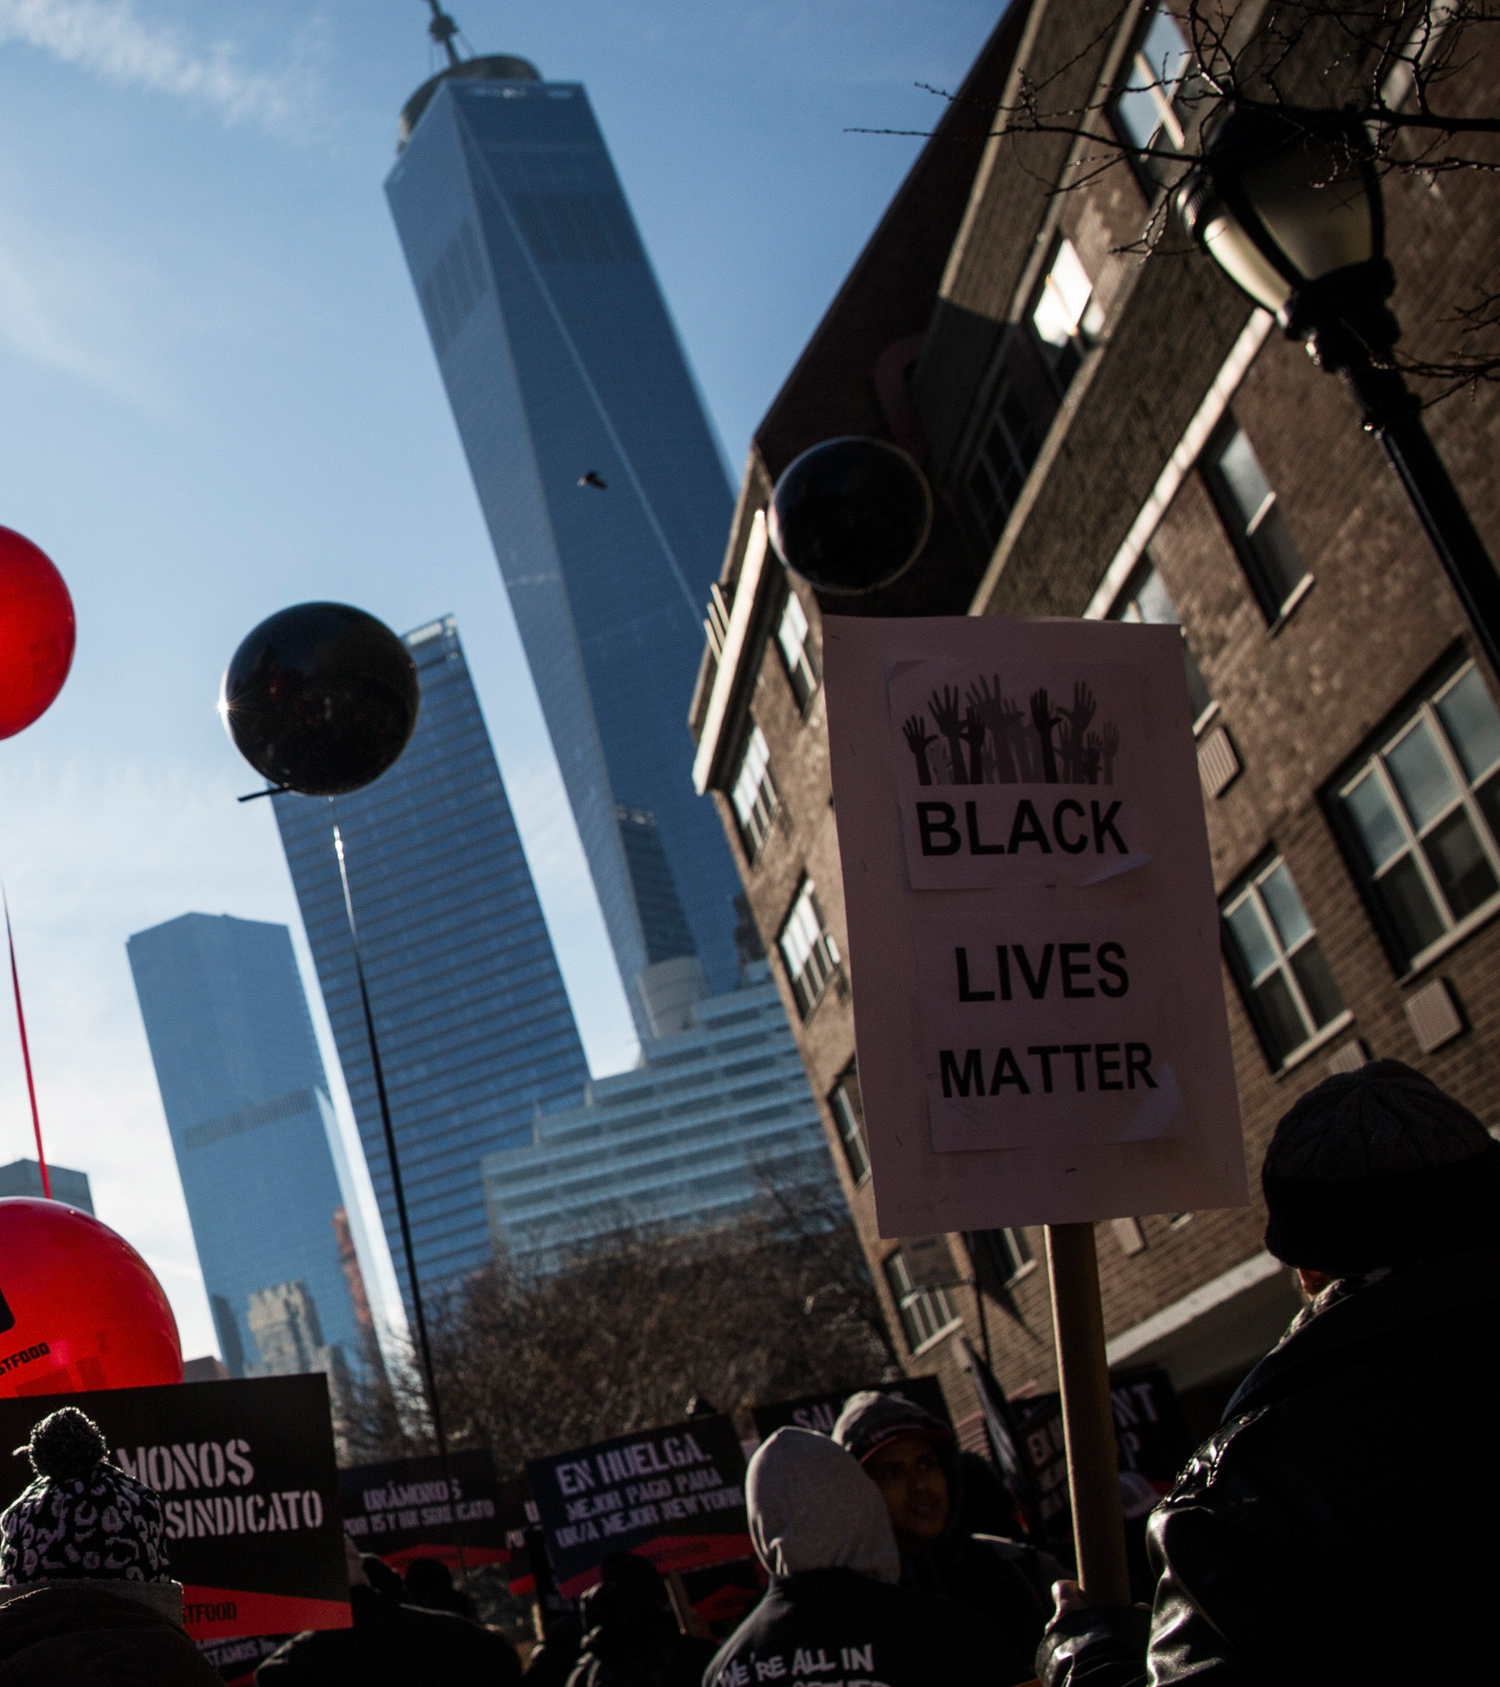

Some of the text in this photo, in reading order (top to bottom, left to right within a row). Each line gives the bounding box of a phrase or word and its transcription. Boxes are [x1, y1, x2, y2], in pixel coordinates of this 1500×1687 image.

[915, 800, 1130, 857] BLACK
[955, 942, 1131, 1002] LIVES
[939, 1041, 1159, 1098] MATTER
[555, 1432, 713, 1498] EN HUELGA.
[164, 1490, 324, 1540] SINDICATO
[791, 1646, 838, 1677] ALL
[840, 1641, 876, 1673] IN
